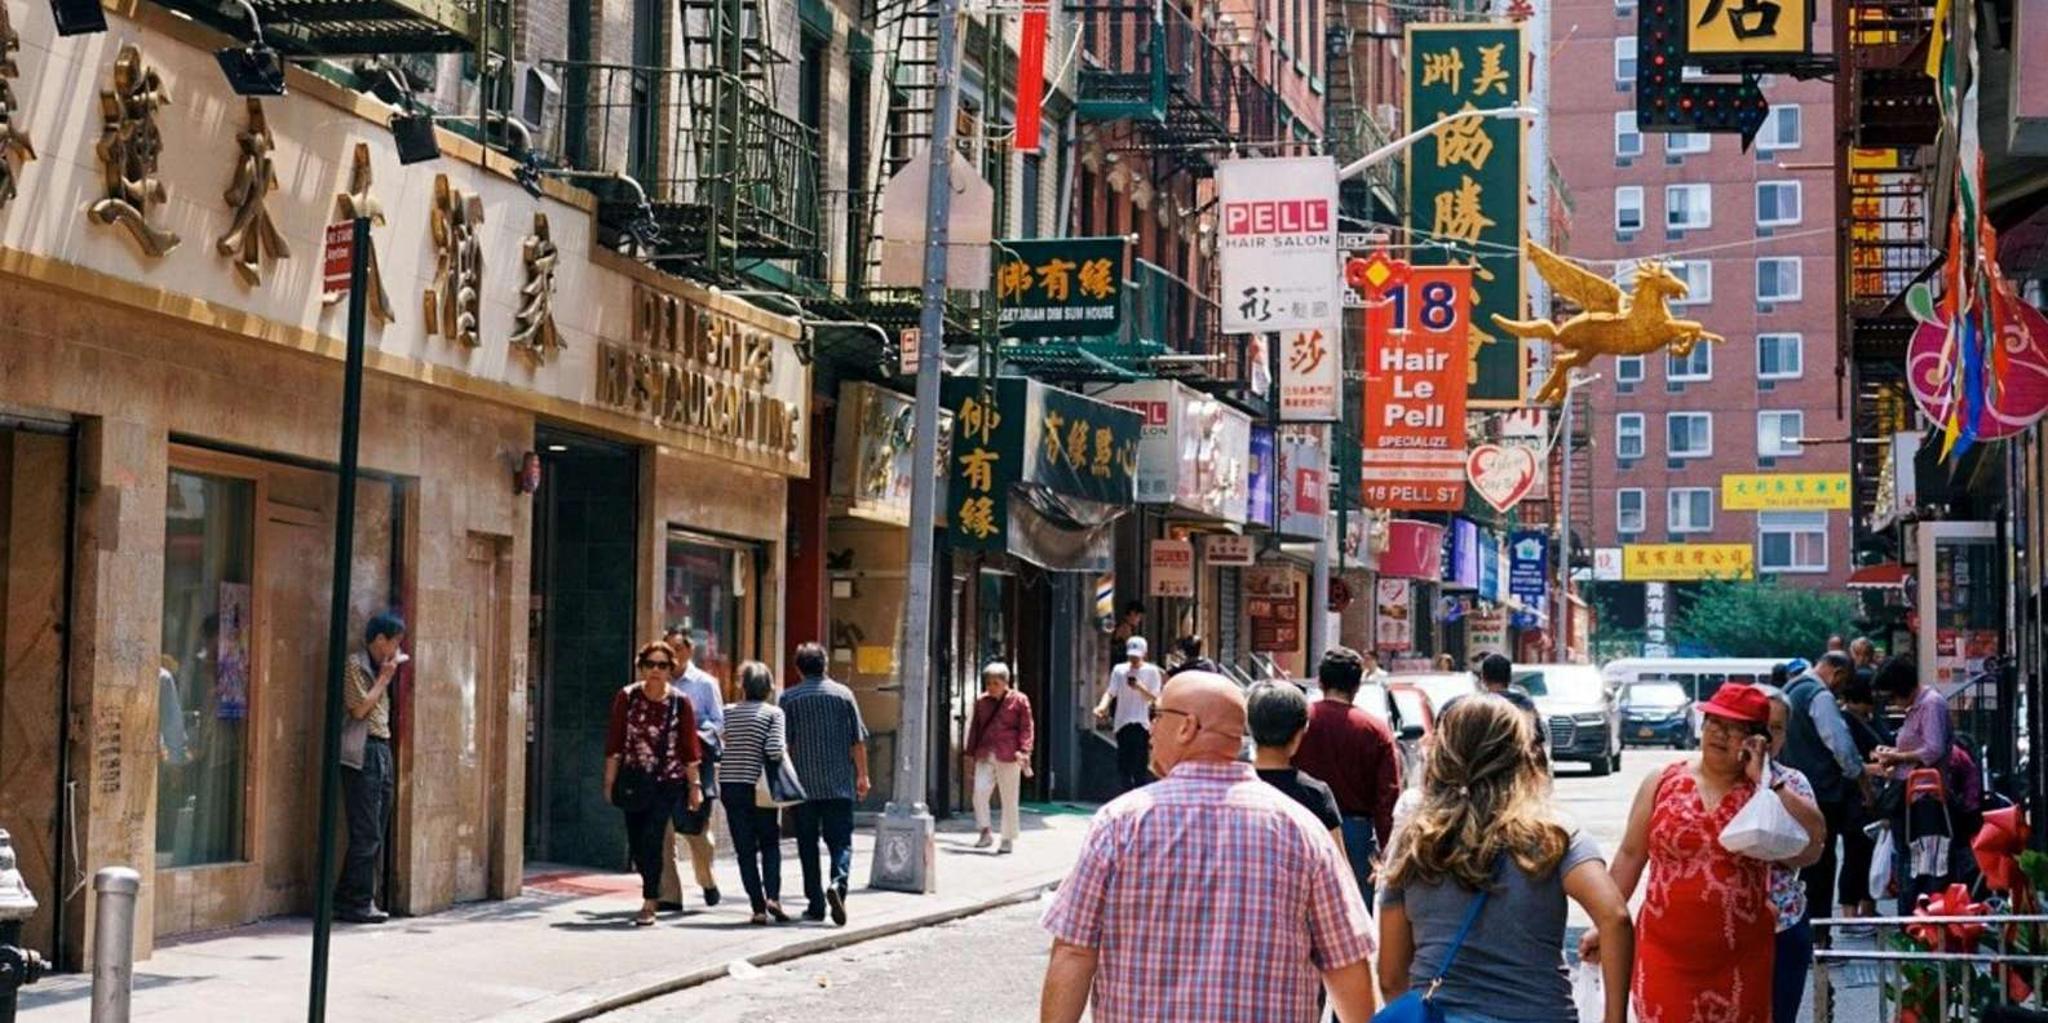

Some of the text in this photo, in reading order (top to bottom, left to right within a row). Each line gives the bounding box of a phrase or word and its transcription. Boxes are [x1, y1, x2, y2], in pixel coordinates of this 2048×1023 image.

[1227, 202, 1326, 232] PELL
[1226, 237, 1267, 248] HAIR
[1273, 234, 1331, 248] SALON
[998, 307, 1046, 321] GETARIAN
[1085, 305, 1115, 320] HOUSE
[1383, 281, 1458, 335] 18
[1380, 347, 1450, 371] Hair
[1394, 375, 1434, 399] Le
[1384, 403, 1445, 428] Pell
[1143, 426, 1168, 436] LON
[1378, 435, 1449, 448] SPECIALIZE
[1367, 486, 1459, 502] 18 PELL ST
